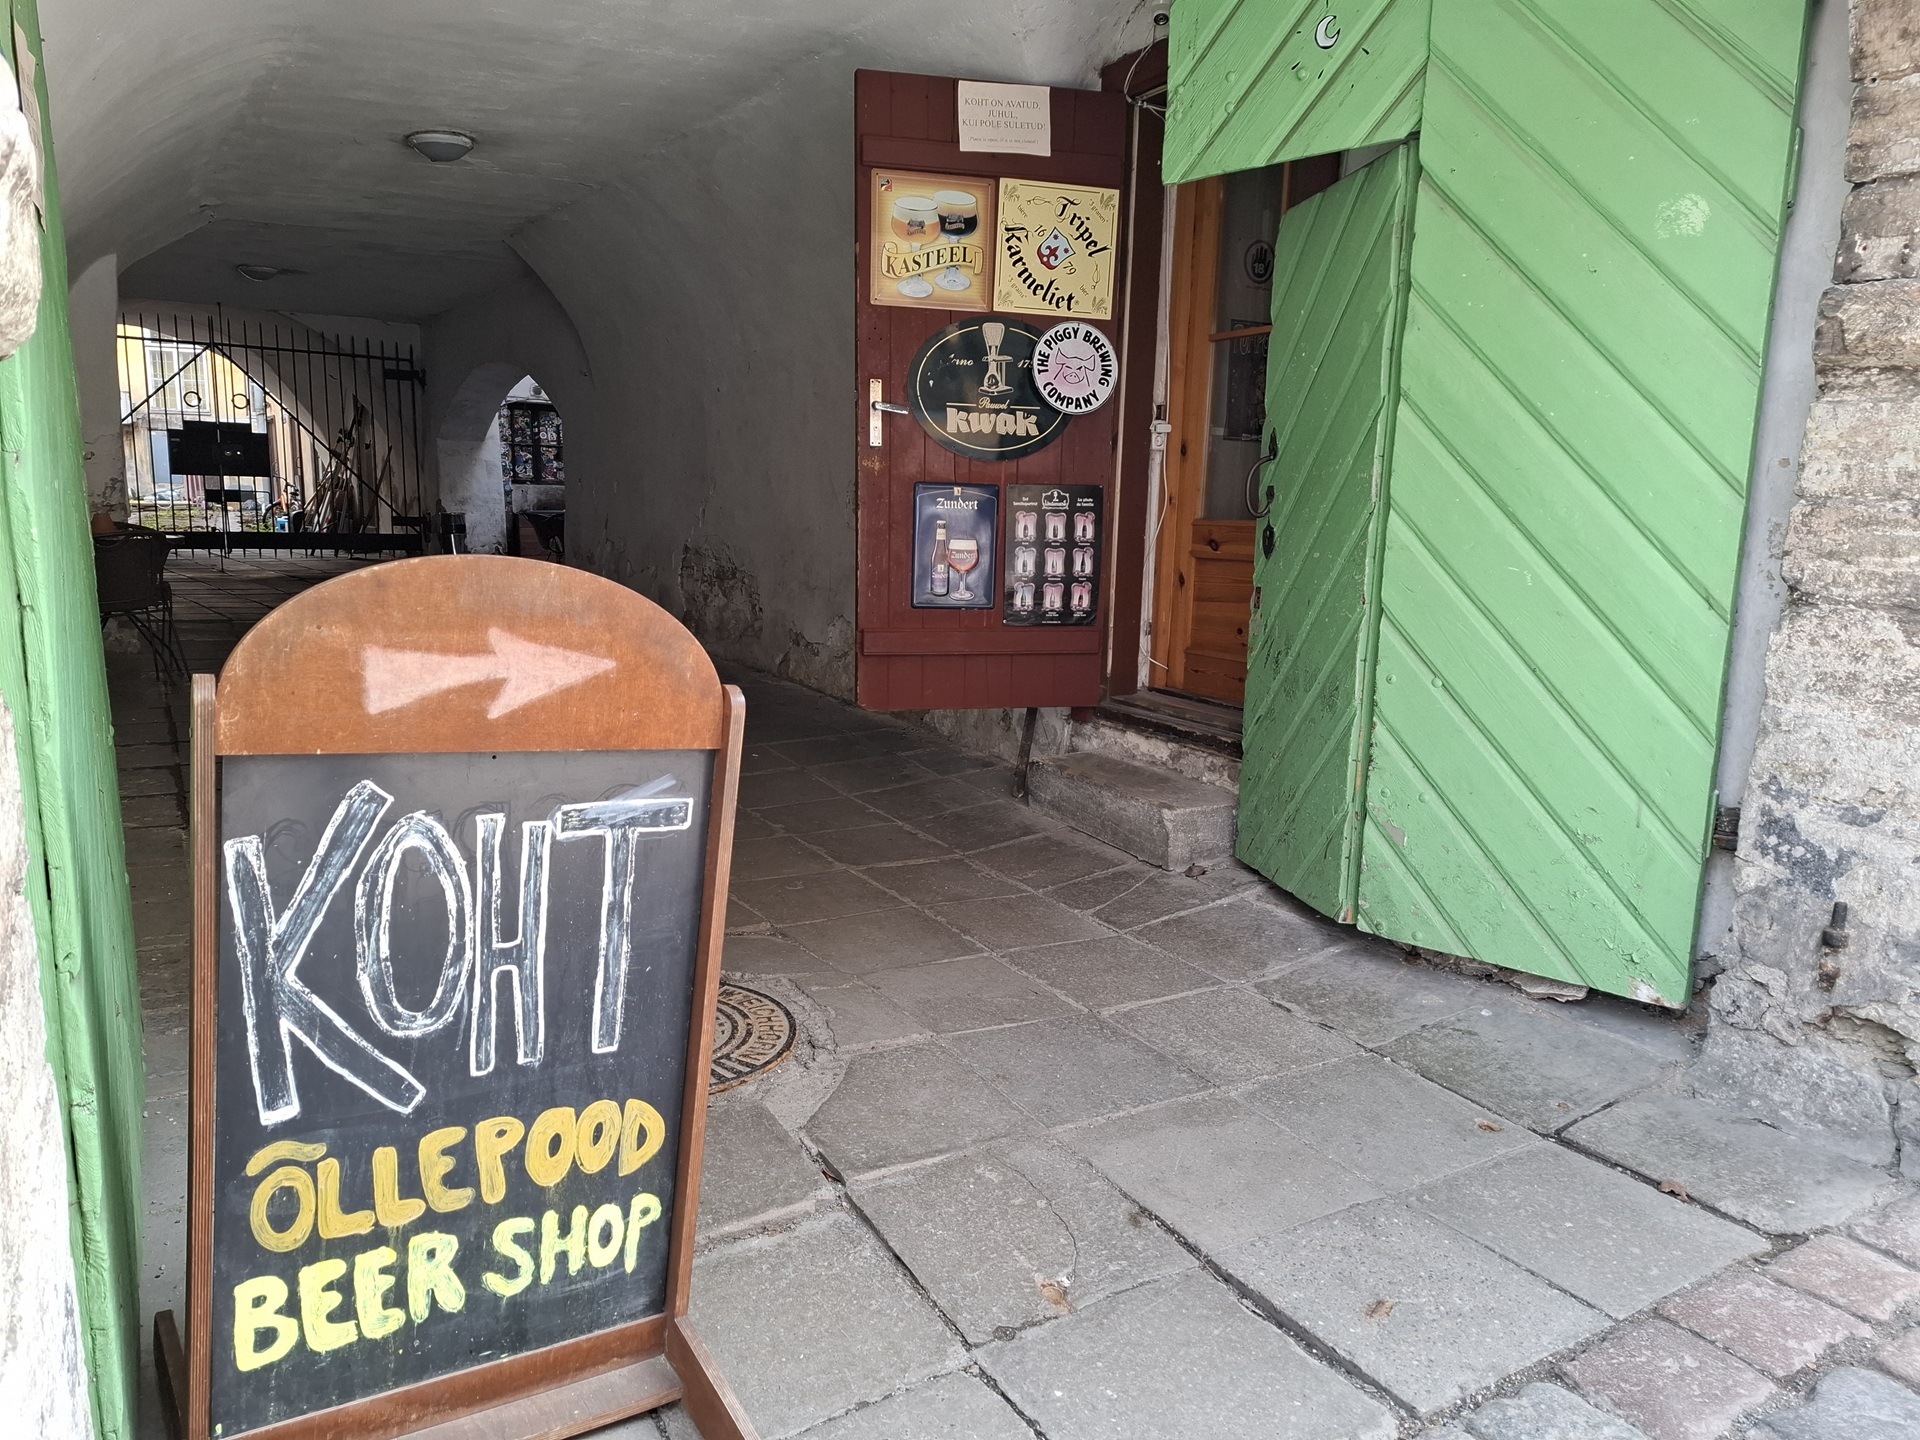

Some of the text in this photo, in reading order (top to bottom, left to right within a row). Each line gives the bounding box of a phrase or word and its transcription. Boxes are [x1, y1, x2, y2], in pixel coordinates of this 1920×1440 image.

[964, 97, 1041, 110] KOHT ON AVATUD,
[987, 109, 1018, 119] JUHUL,
[962, 118, 1046, 130] KUI POLE SULETUD!
[1034, 223, 1048, 238] 16
[1055, 196, 1112, 258] Tripel
[885, 246, 973, 278] KASTEEL
[1063, 261, 1077, 276] 79
[1253, 262, 1265, 274] 18
[1037, 326, 1112, 388] THE PIGGY BREWING
[1042, 381, 1100, 410] COMPANY
[935, 496, 979, 510] Zundert
[223, 779, 694, 1126] KOHT
[245, 1098, 666, 1252] ÕLLEPOOD
[233, 1192, 662, 1372] BEER SHOP
